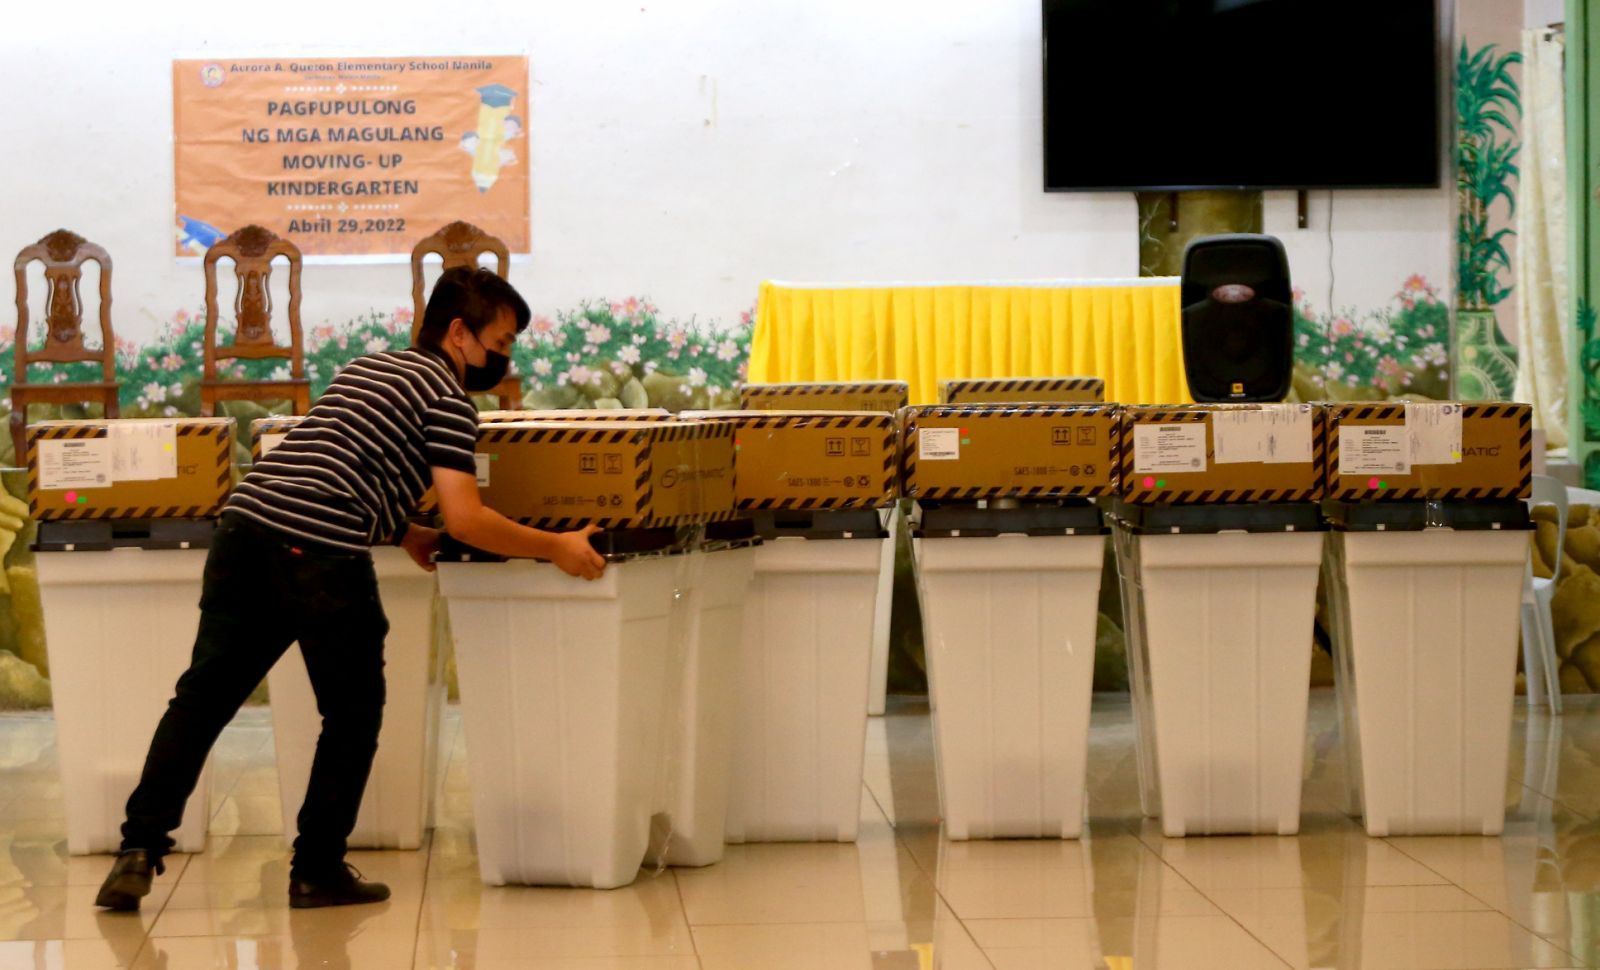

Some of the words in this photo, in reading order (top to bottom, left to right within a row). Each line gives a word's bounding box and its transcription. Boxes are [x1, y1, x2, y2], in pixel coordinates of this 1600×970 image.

[337, 61, 406, 72] Elementary
[409, 60, 449, 71] School
[452, 60, 492, 71] Manila
[267, 100, 416, 117] PAGPUPULONG
[242, 127, 270, 143] NG
[276, 127, 322, 143] MGA
[327, 126, 445, 142] MAGULANG
[283, 153, 373, 169] MOVING-
[378, 153, 403, 168] UP
[267, 180, 419, 196] KINDERGARTEN
[288, 217, 331, 234] Abril
[337, 217, 406, 234] 29,2022
